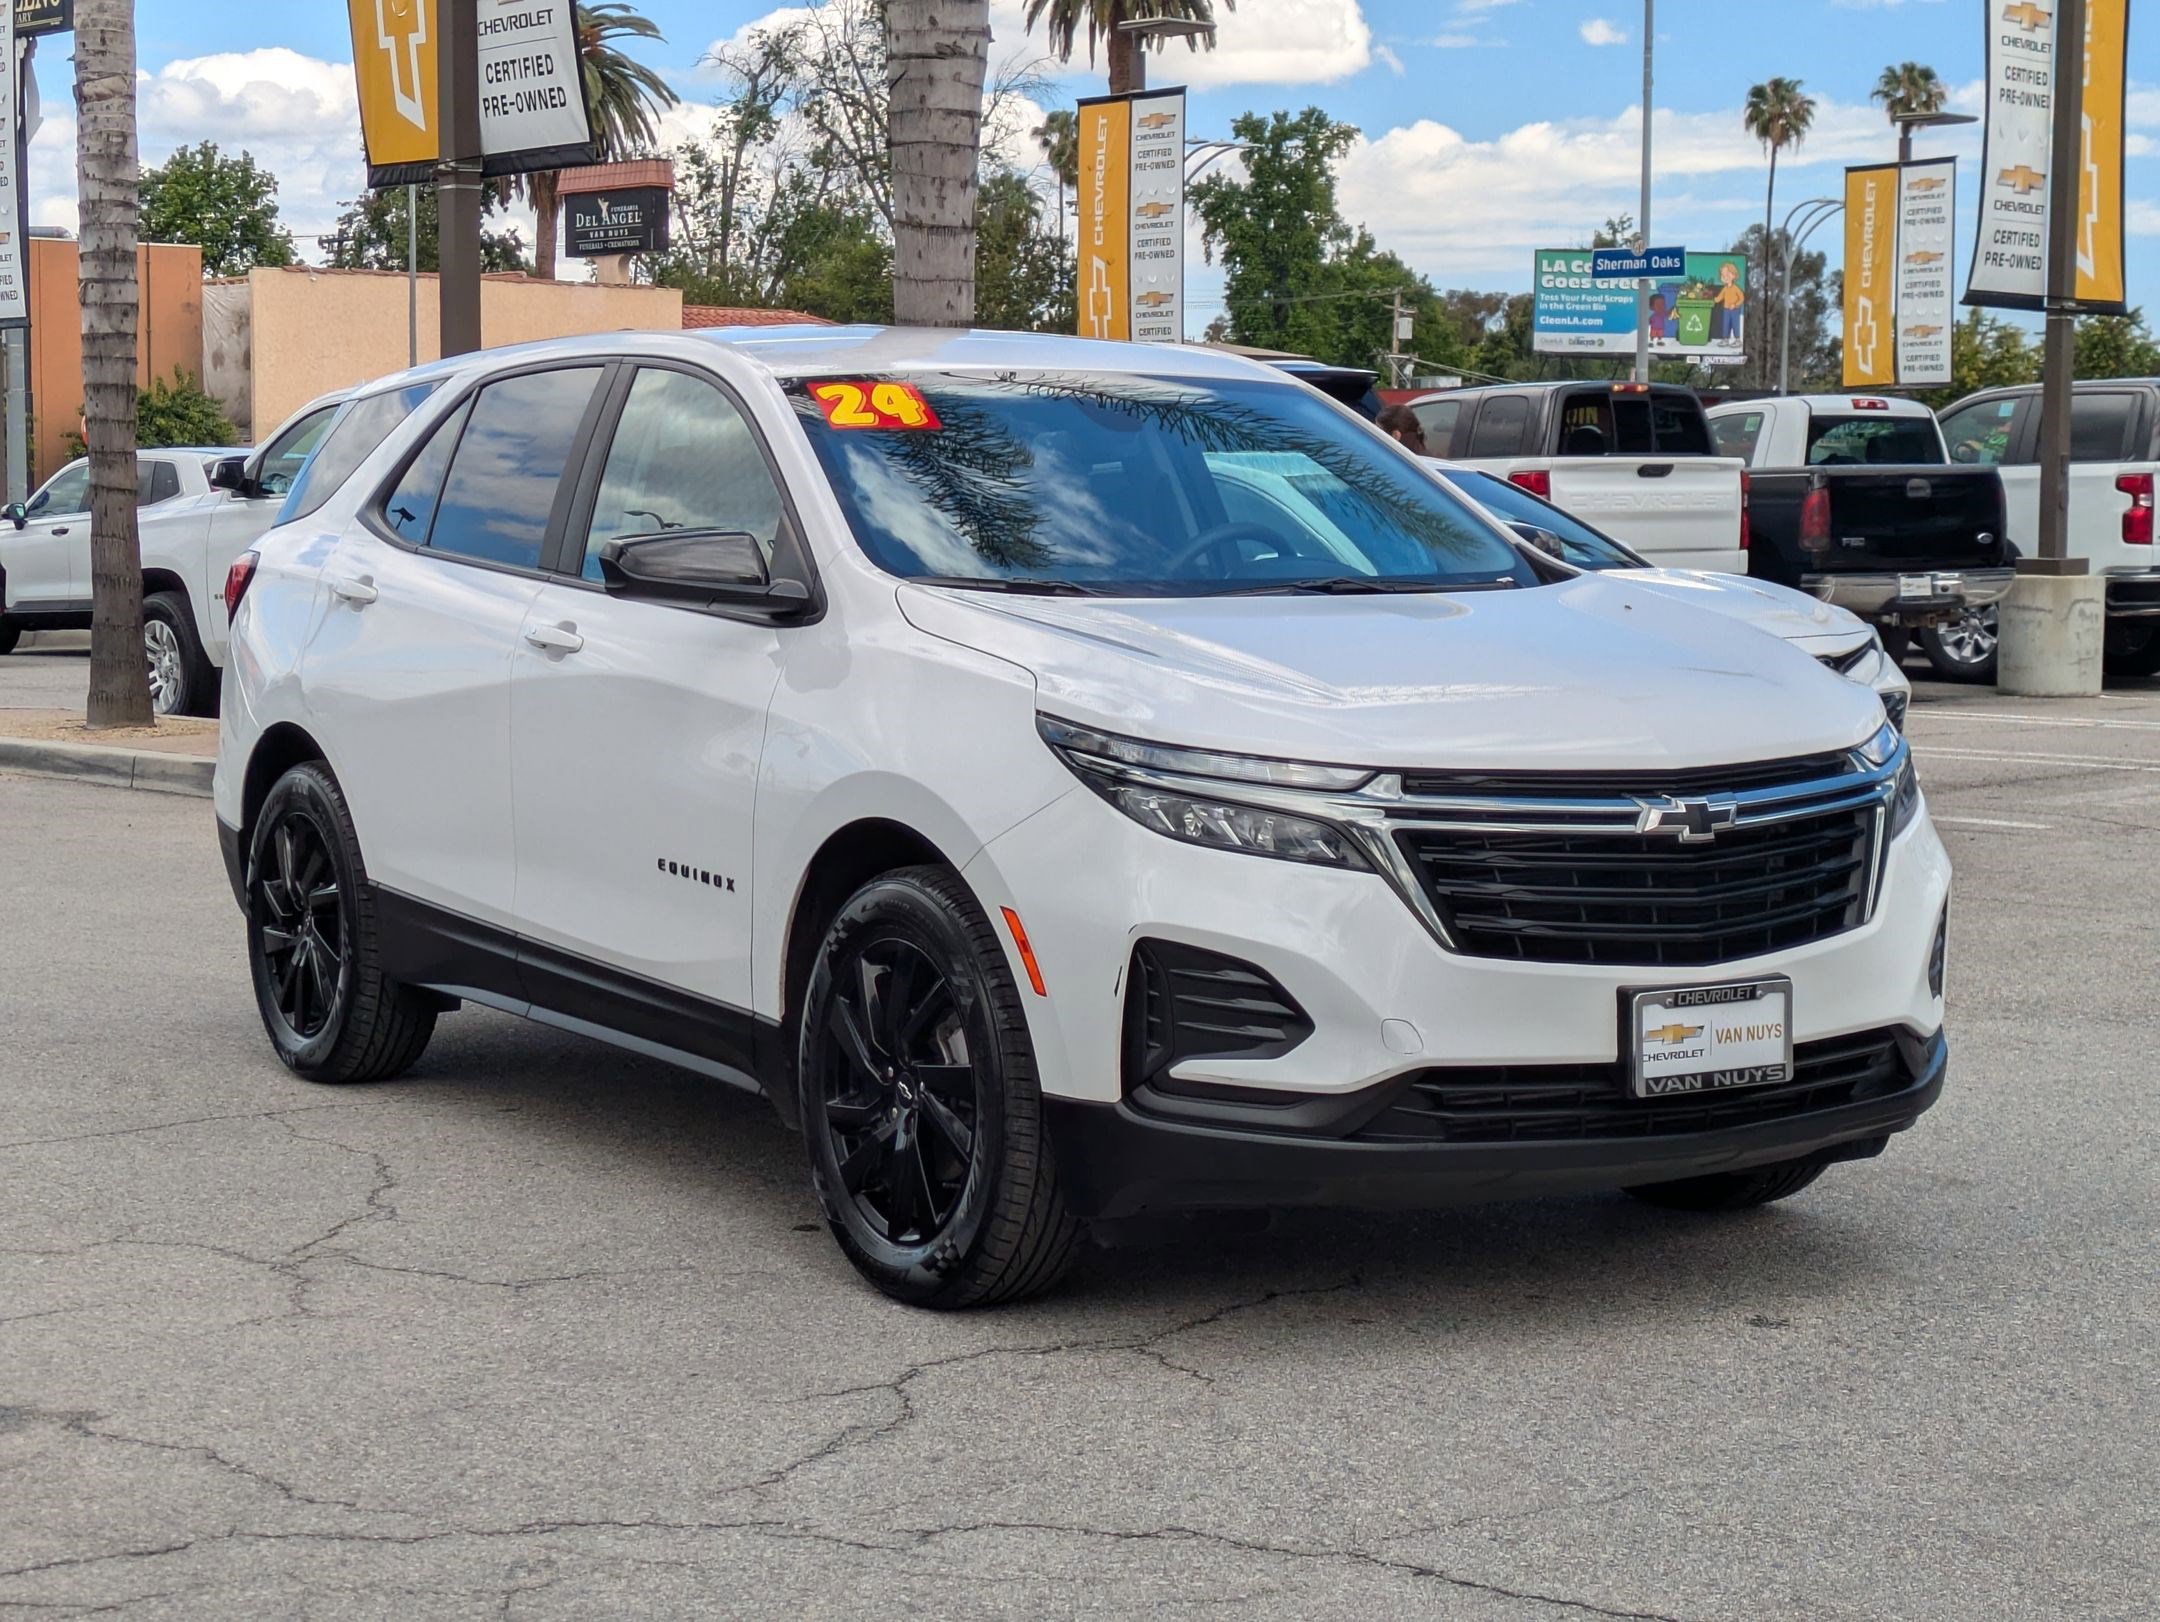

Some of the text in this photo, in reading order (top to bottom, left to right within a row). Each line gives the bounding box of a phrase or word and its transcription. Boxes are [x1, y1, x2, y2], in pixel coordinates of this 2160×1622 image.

[478, 9, 553, 37] CHEVROLET
[2001, 35, 2052, 54] CHEVROLET
[485, 54, 554, 84] CERTIFIED
[2005, 65, 2048, 86] CERTIFIED
[482, 86, 567, 118] PRE-OWNED
[1135, 131, 1176, 141] CHEVROLET
[1137, 148, 1172, 159] CERTIFIED
[1135, 160, 1176, 171] PRE-OWNED
[1094, 115, 1108, 245] CHEVROLET
[1906, 206, 1942, 216] CERTIFIED
[1994, 200, 2045, 215] CHEVROLET
[576, 211, 642, 228] DEL ANGEL
[1134, 221, 1174, 231] CHEVROLET
[1904, 216, 1946, 226] PRE-OWNED
[589, 228, 629, 239] VAN NUYS
[1861, 179, 1876, 288] CHEVROLET
[1993, 229, 2040, 248] CERTIFIED
[1136, 237, 1171, 248] CERTIFIED
[1134, 249, 1175, 260] PRE-OWNED
[1984, 251, 2043, 270] PRE-OWNED
[1542, 260, 1568, 273] LA
[1596, 255, 1681, 271] Sherman Oaks
[1541, 275, 1592, 289] Goes
[1905, 280, 1941, 289] CERTIFIED
[1561, 293, 1580, 303] Your
[1902, 291, 1944, 299] PRE-OWNED
[1549, 302, 1564, 311] the
[1135, 310, 1174, 319] CHEVROLET
[1539, 316, 1604, 326] CleanLA.com
[1138, 327, 1172, 337] CERTIFIED
[1905, 353, 1940, 362] CERTIFIED
[1903, 363, 1944, 372] PRE-OWNED
[815, 384, 929, 426] 24
[657, 858, 735, 893] EQUINOX
[1678, 986, 1752, 1006] CHEVROLET
[1716, 1023, 1782, 1044] VAN NUYS
[1643, 1049, 1705, 1063] CHEVROLET
[1648, 1065, 1784, 1093] VAN NUYS
